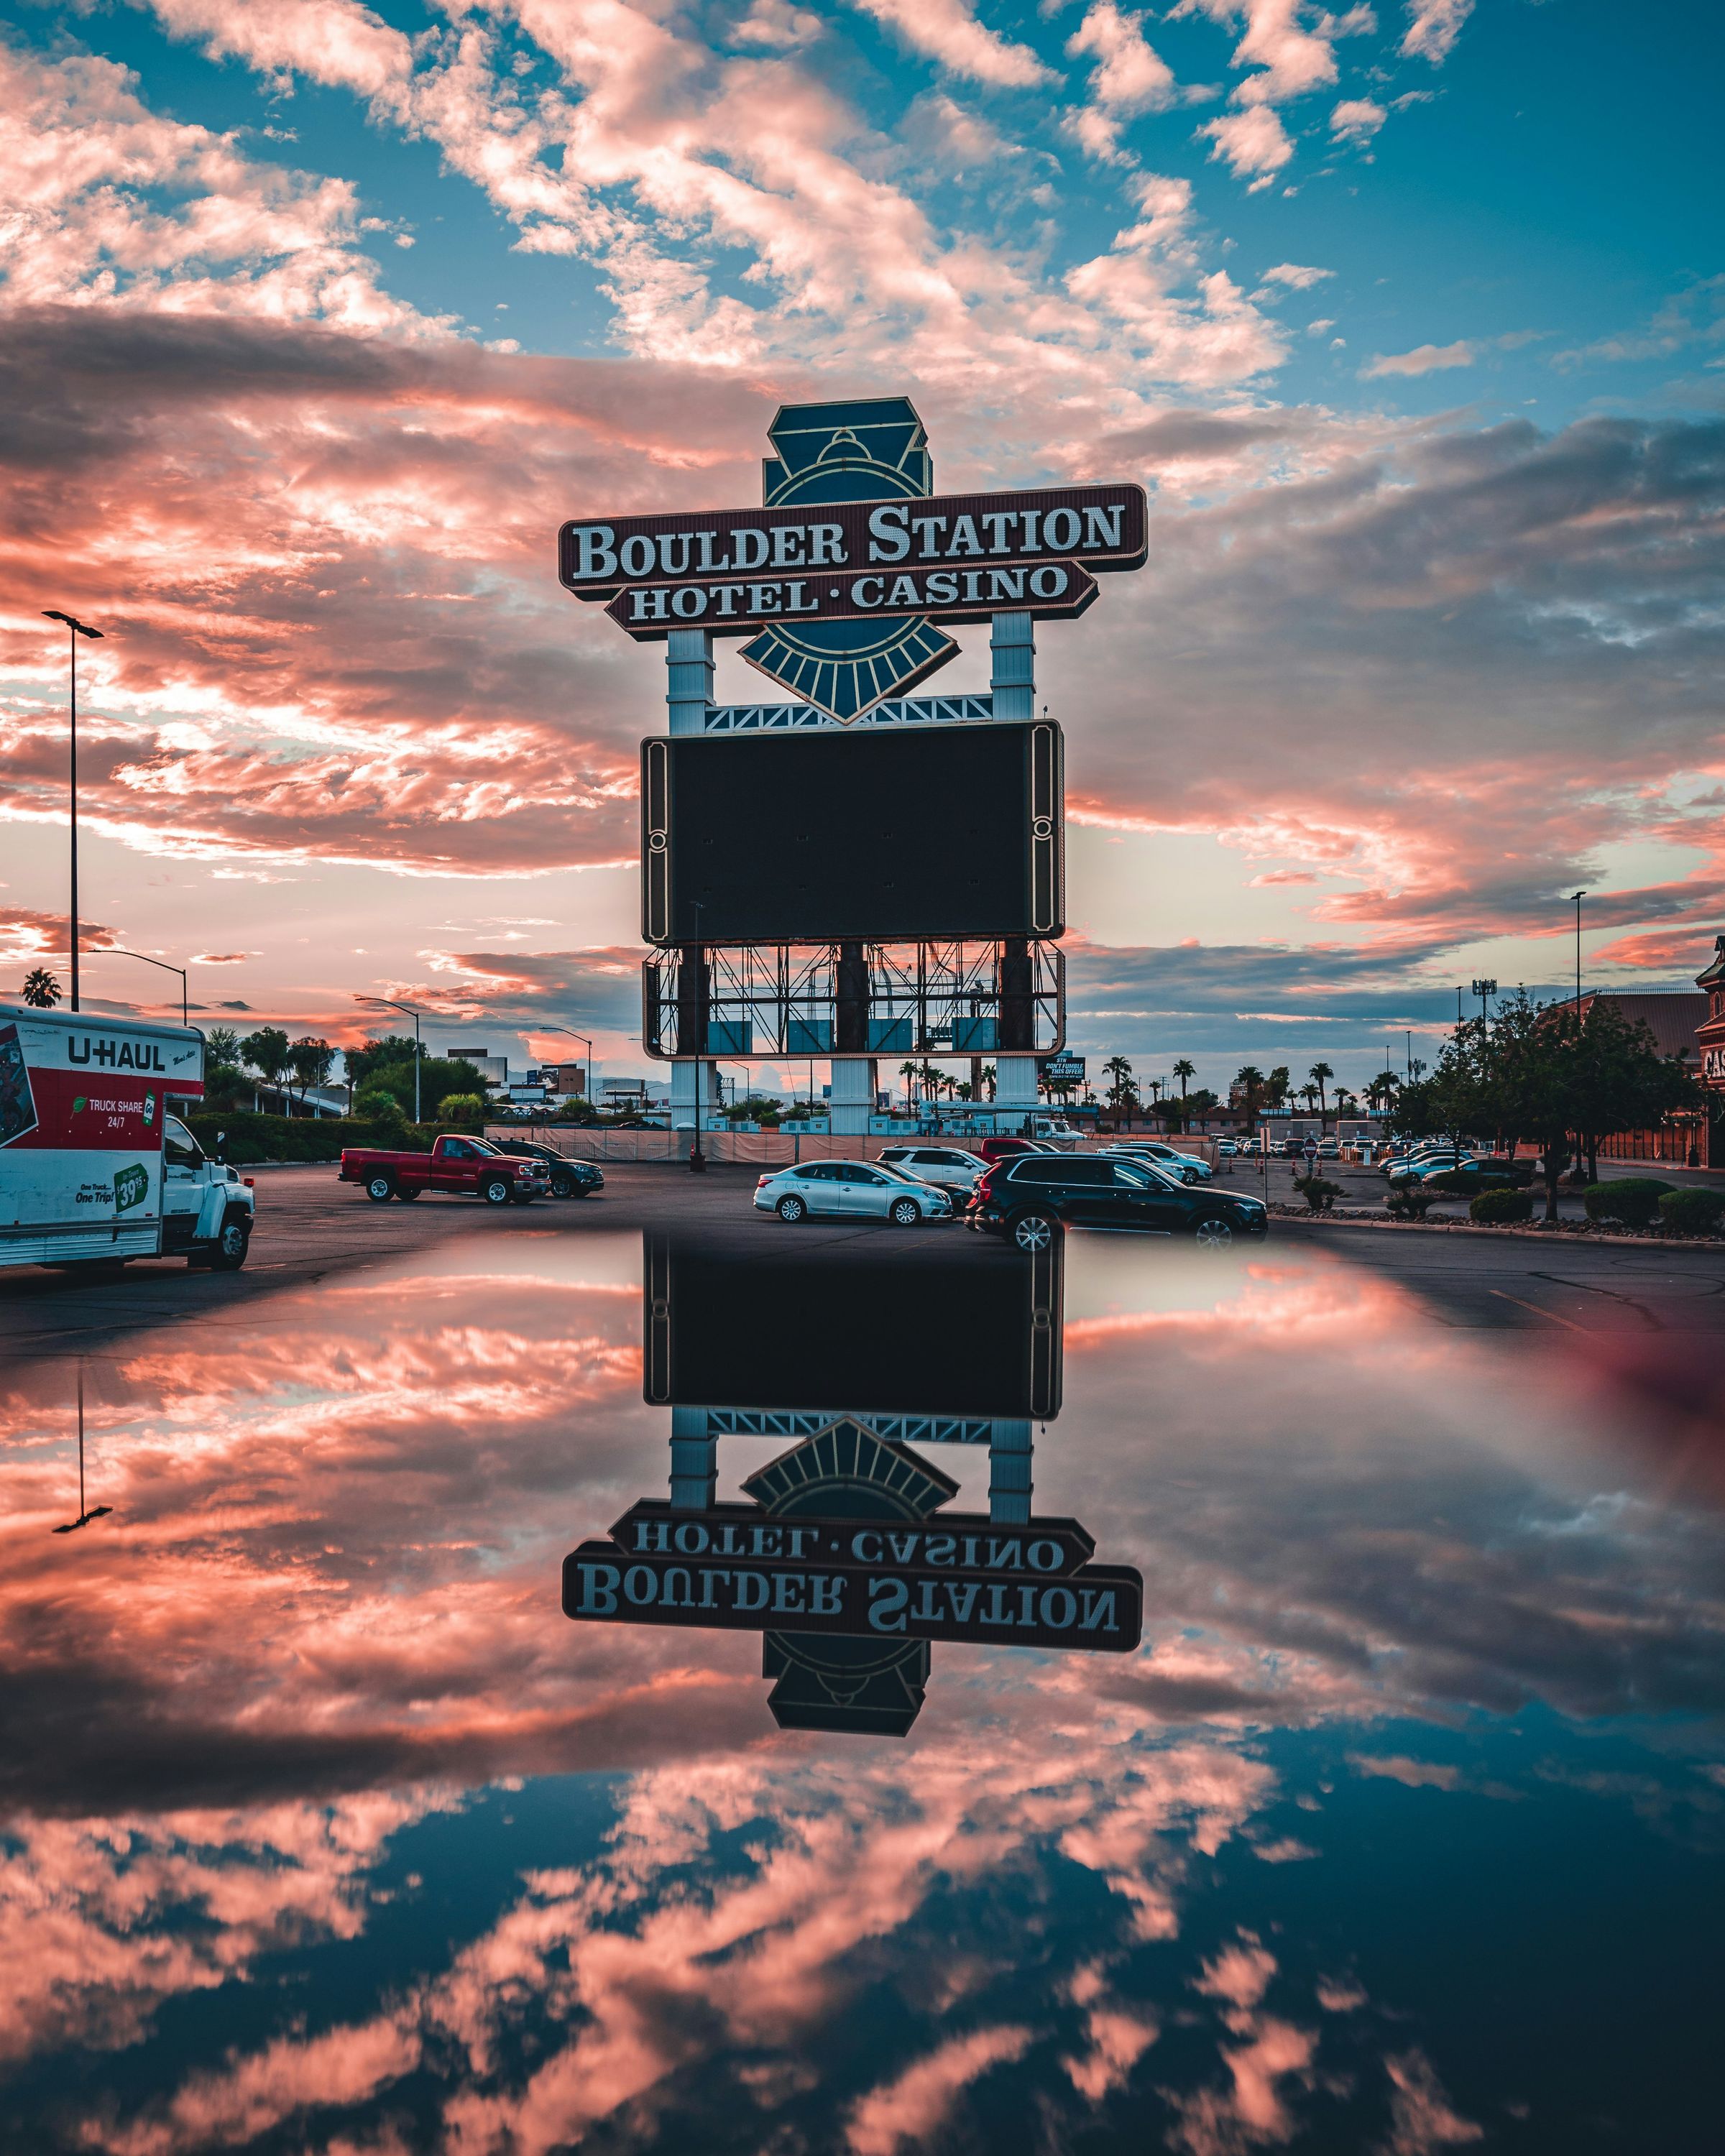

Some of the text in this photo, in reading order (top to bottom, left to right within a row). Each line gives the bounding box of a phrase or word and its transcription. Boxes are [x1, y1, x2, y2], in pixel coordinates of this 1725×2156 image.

[573, 505, 1126, 579] BOULDER STATION
[628, 566, 1068, 620] HOTEL CASINO
[68, 1036, 165, 1072] U-HAUL
[89, 1100, 143, 1113] TRUCK SHARE
[108, 1117, 125, 1129] 24/7
[75, 1191, 115, 1204] One Trip!
